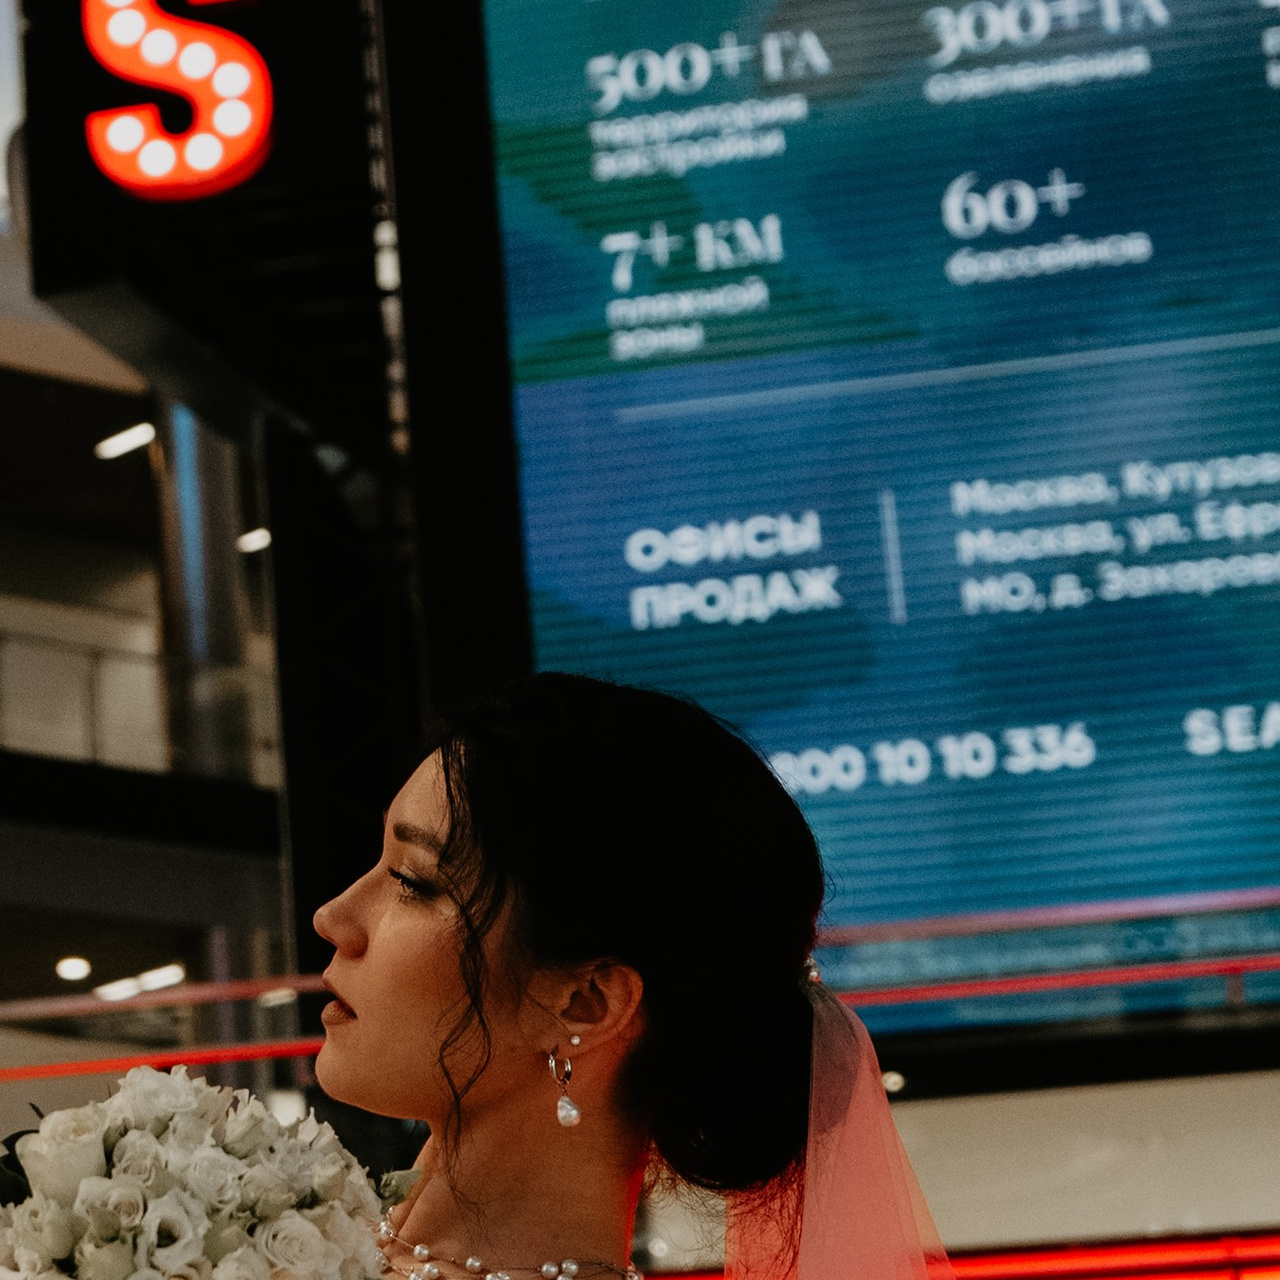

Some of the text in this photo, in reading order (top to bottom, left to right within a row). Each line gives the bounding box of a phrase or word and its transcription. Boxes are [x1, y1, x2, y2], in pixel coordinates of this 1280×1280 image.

[584, 30, 757, 117] 500+
[941, 167, 1087, 240] 60+
[623, 510, 821, 573] ОФИСЫ
[629, 565, 844, 631] ПРОДАЖ
[872, 738, 932, 786] 10
[937, 731, 997, 780] 10
[1002, 721, 1097, 775] 336
